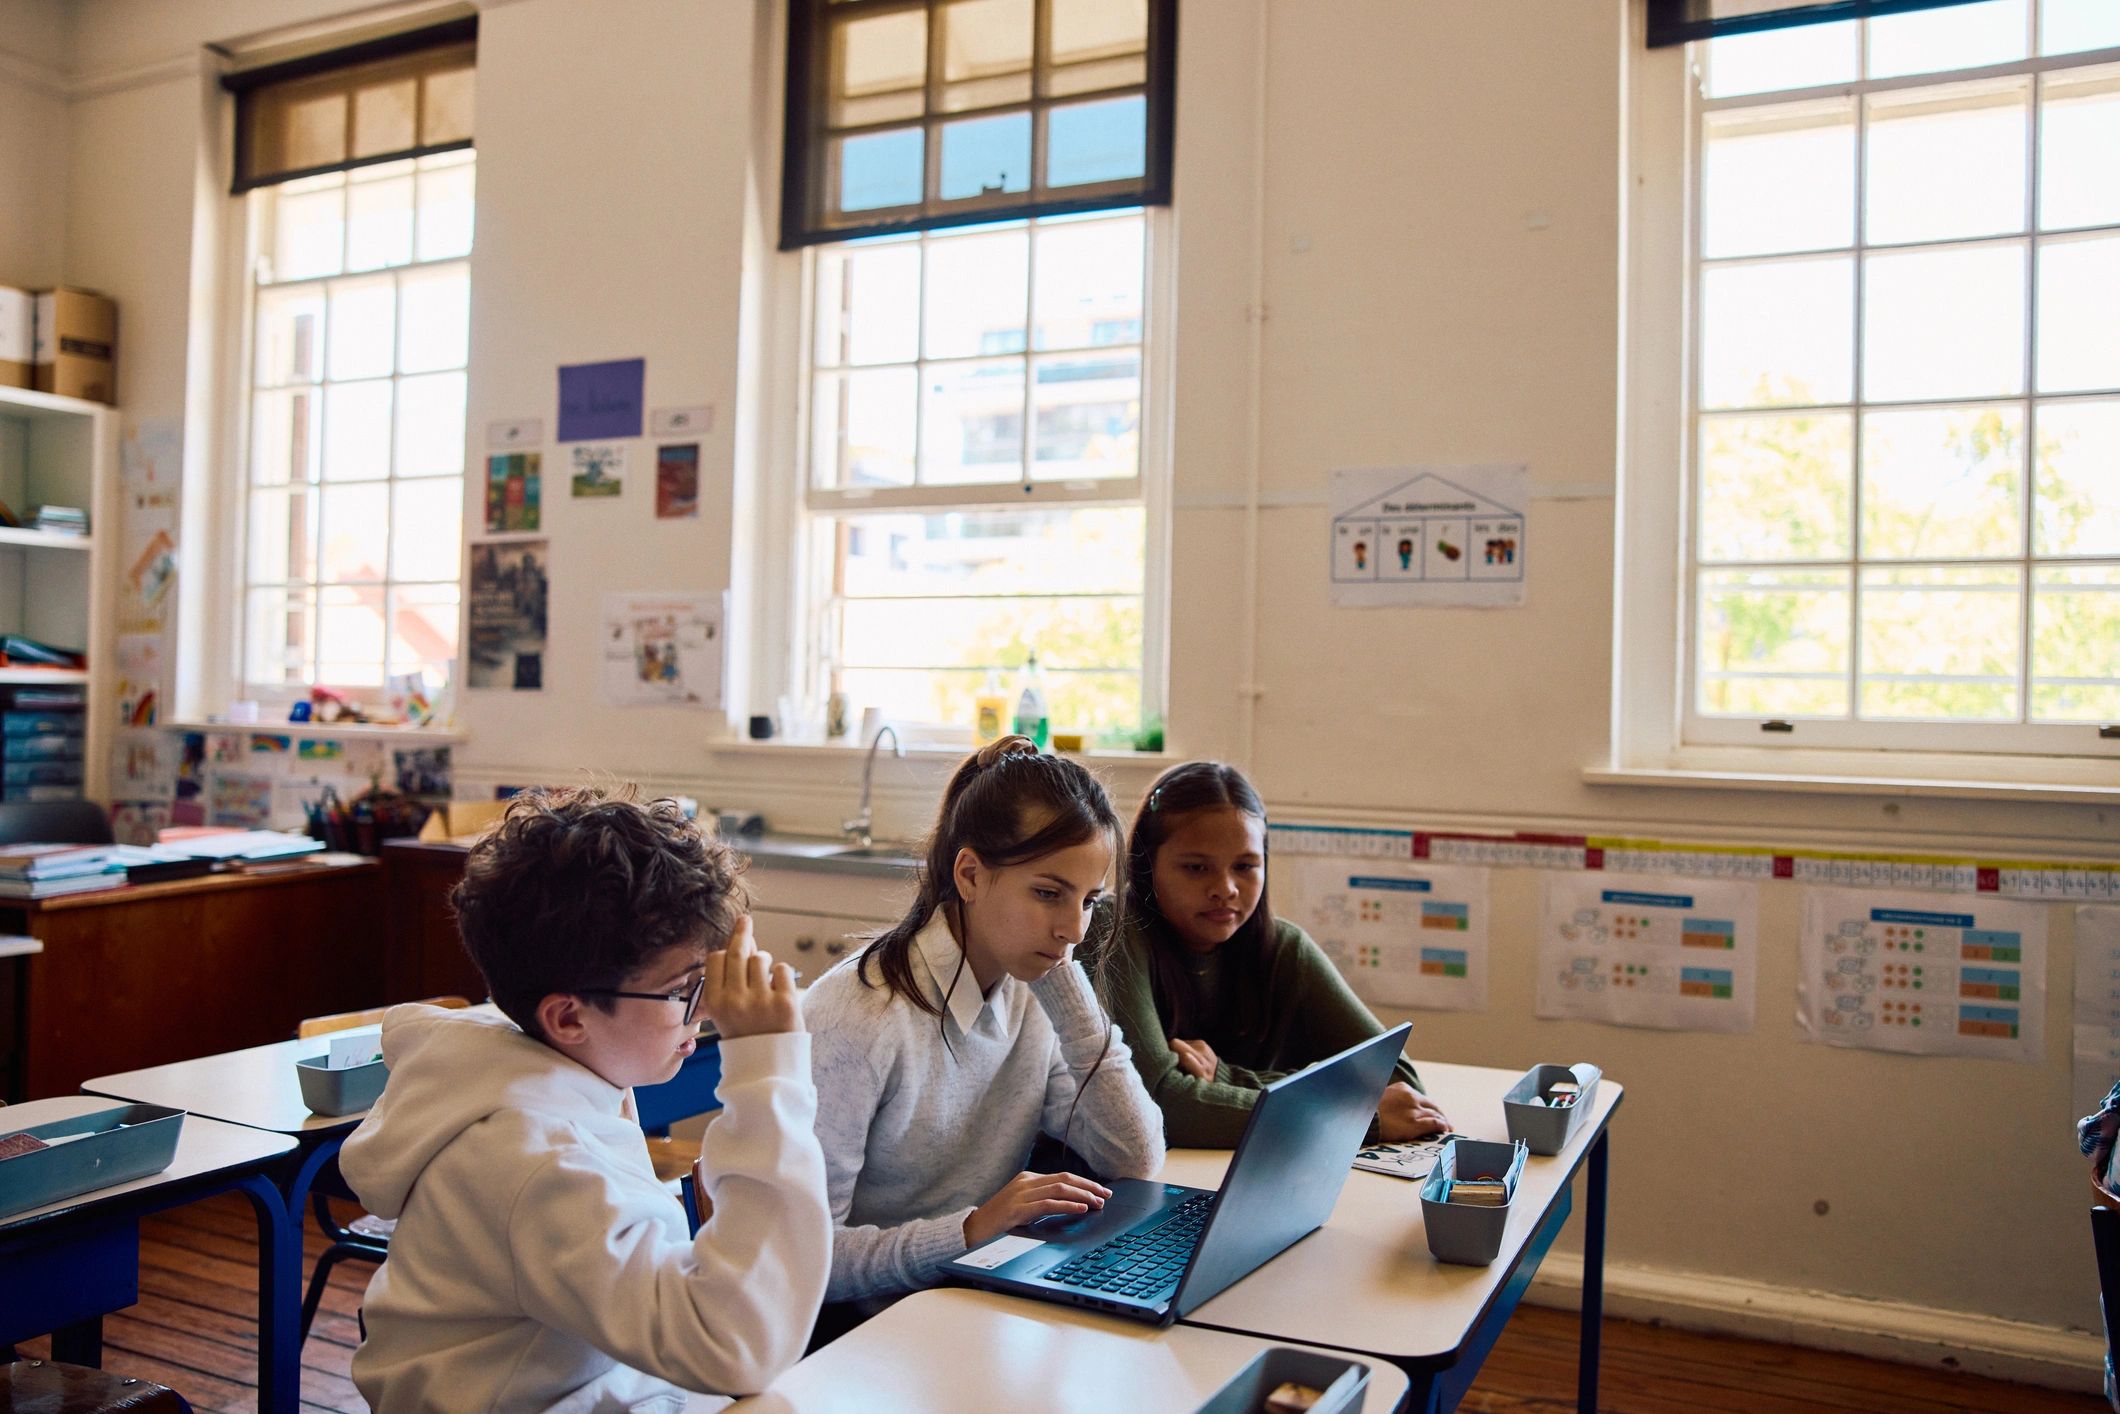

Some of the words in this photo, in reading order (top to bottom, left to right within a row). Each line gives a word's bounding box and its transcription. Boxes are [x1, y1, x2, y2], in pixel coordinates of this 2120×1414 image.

[1854, 866, 1870, 879] 34
[1875, 866, 1890, 880] 35
[1896, 868, 1910, 881] 36
[1916, 869, 1931, 882] 37
[1936, 869, 1952, 882] 38
[1958, 870, 1974, 883] 39
[1979, 873, 1997, 887] 40
[2001, 874, 2017, 887] 41
[2022, 875, 2039, 889] 42
[2043, 876, 2062, 889] 43
[2066, 877, 2084, 889] 44
[2088, 877, 2107, 891] 45
